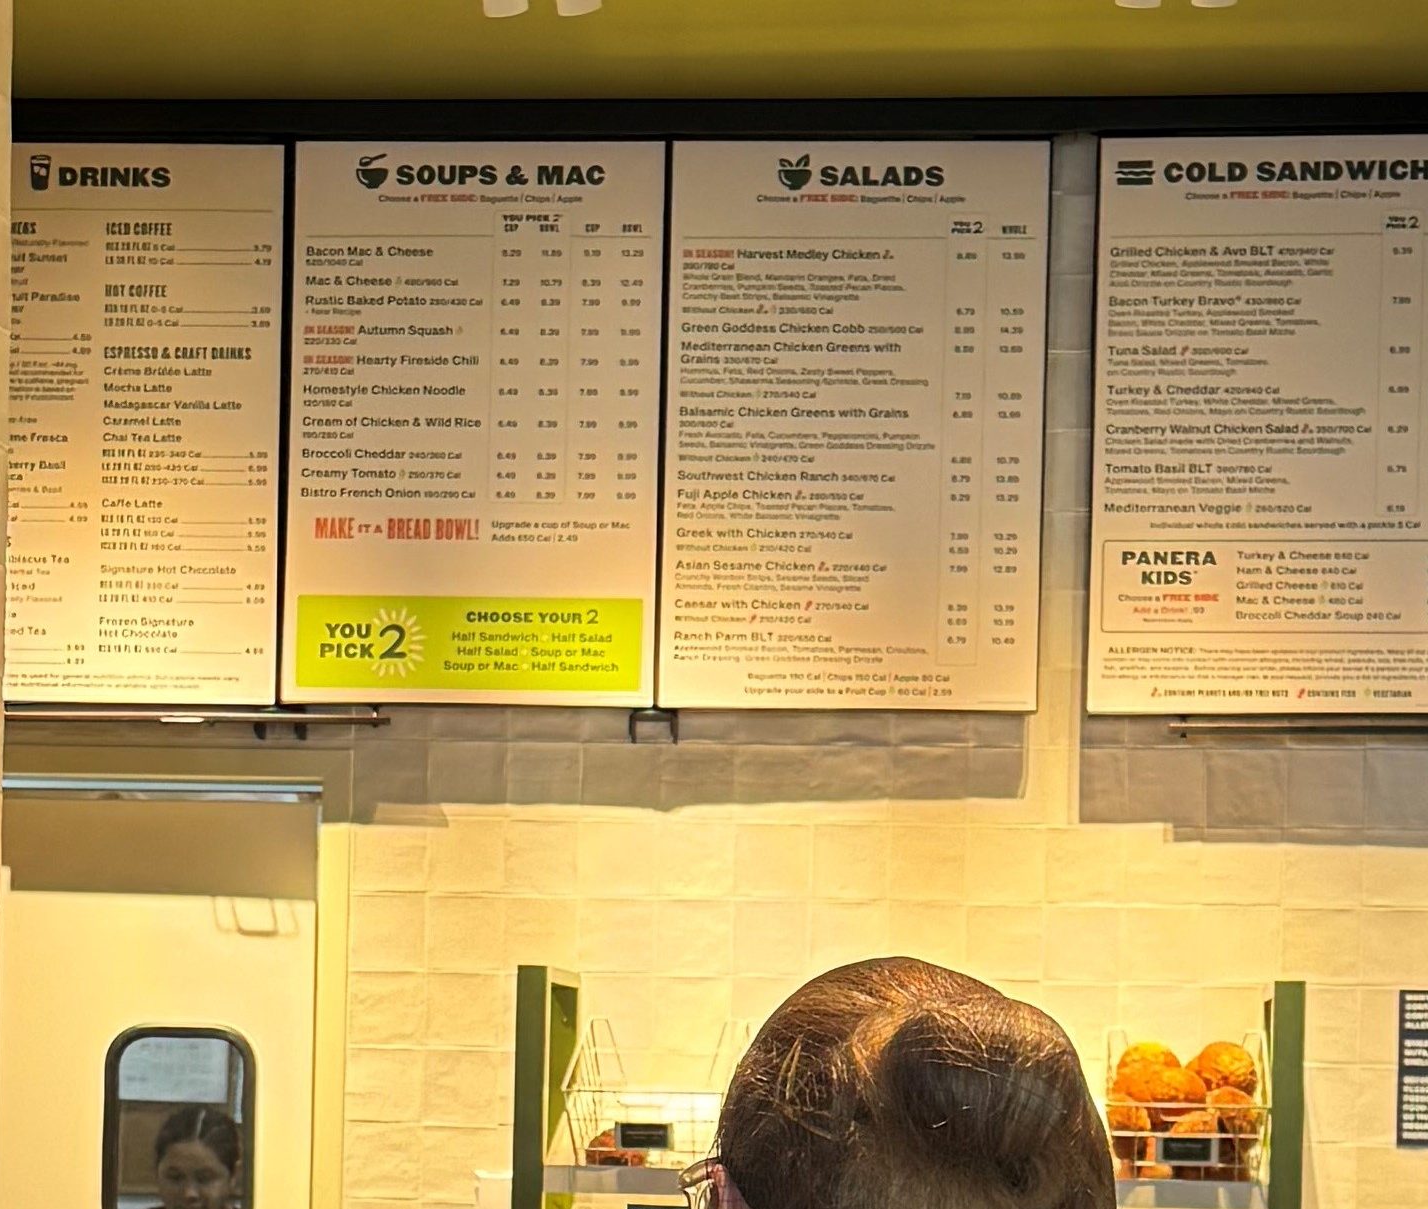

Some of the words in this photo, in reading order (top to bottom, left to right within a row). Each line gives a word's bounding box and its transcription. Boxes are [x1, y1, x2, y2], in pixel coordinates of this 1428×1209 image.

[58, 166, 171, 187] DRINKS
[396, 164, 497, 185] SOUPS
[505, 165, 528, 185] &
[537, 165, 605, 185] MAC
[819, 166, 944, 186] SALADS
[1163, 162, 1248, 182] COLD
[105, 222, 130, 235] ICED
[133, 222, 172, 235] COFFEE
[304, 245, 346, 257] Bacon
[346, 246, 372, 257] Mac
[374, 246, 384, 257] &
[386, 245, 434, 257] Cheese
[128, 284, 167, 297] COFFEE
[681, 322, 718, 333] Green
[721, 322, 776, 333] Goddess
[778, 322, 829, 333] Chicken
[831, 323, 865, 333] Cobb
[160, 346, 171, 359] &
[174, 346, 207, 359] CRAFT
[1106, 384, 1151, 398] Turkey
[1152, 385, 1163, 395] &
[1164, 384, 1222, 396] Cheddar
[301, 448, 351, 458] Broccoli
[354, 448, 406, 458] Cheddar
[300, 467, 348, 479] Creamy
[350, 468, 396, 478] Tomato
[677, 470, 744, 480] Southwest
[747, 470, 797, 481] Chicken
[799, 470, 839, 481] Ranch
[315, 517, 355, 538] MAKE
[357, 523, 371, 533] IT
[373, 524, 383, 533] A
[387, 517, 431, 539] BREAD
[435, 518, 479, 540] BOWL!
[1121, 551, 1217, 565] PANERA
[1141, 570, 1192, 584] KIDS
[465, 611, 533, 622] CHOOSE
[538, 612, 582, 623] YOUR
[586, 609, 598, 623] 2
[325, 623, 372, 638] YOU
[319, 642, 375, 659] PICK
[378, 623, 408, 660] 2
